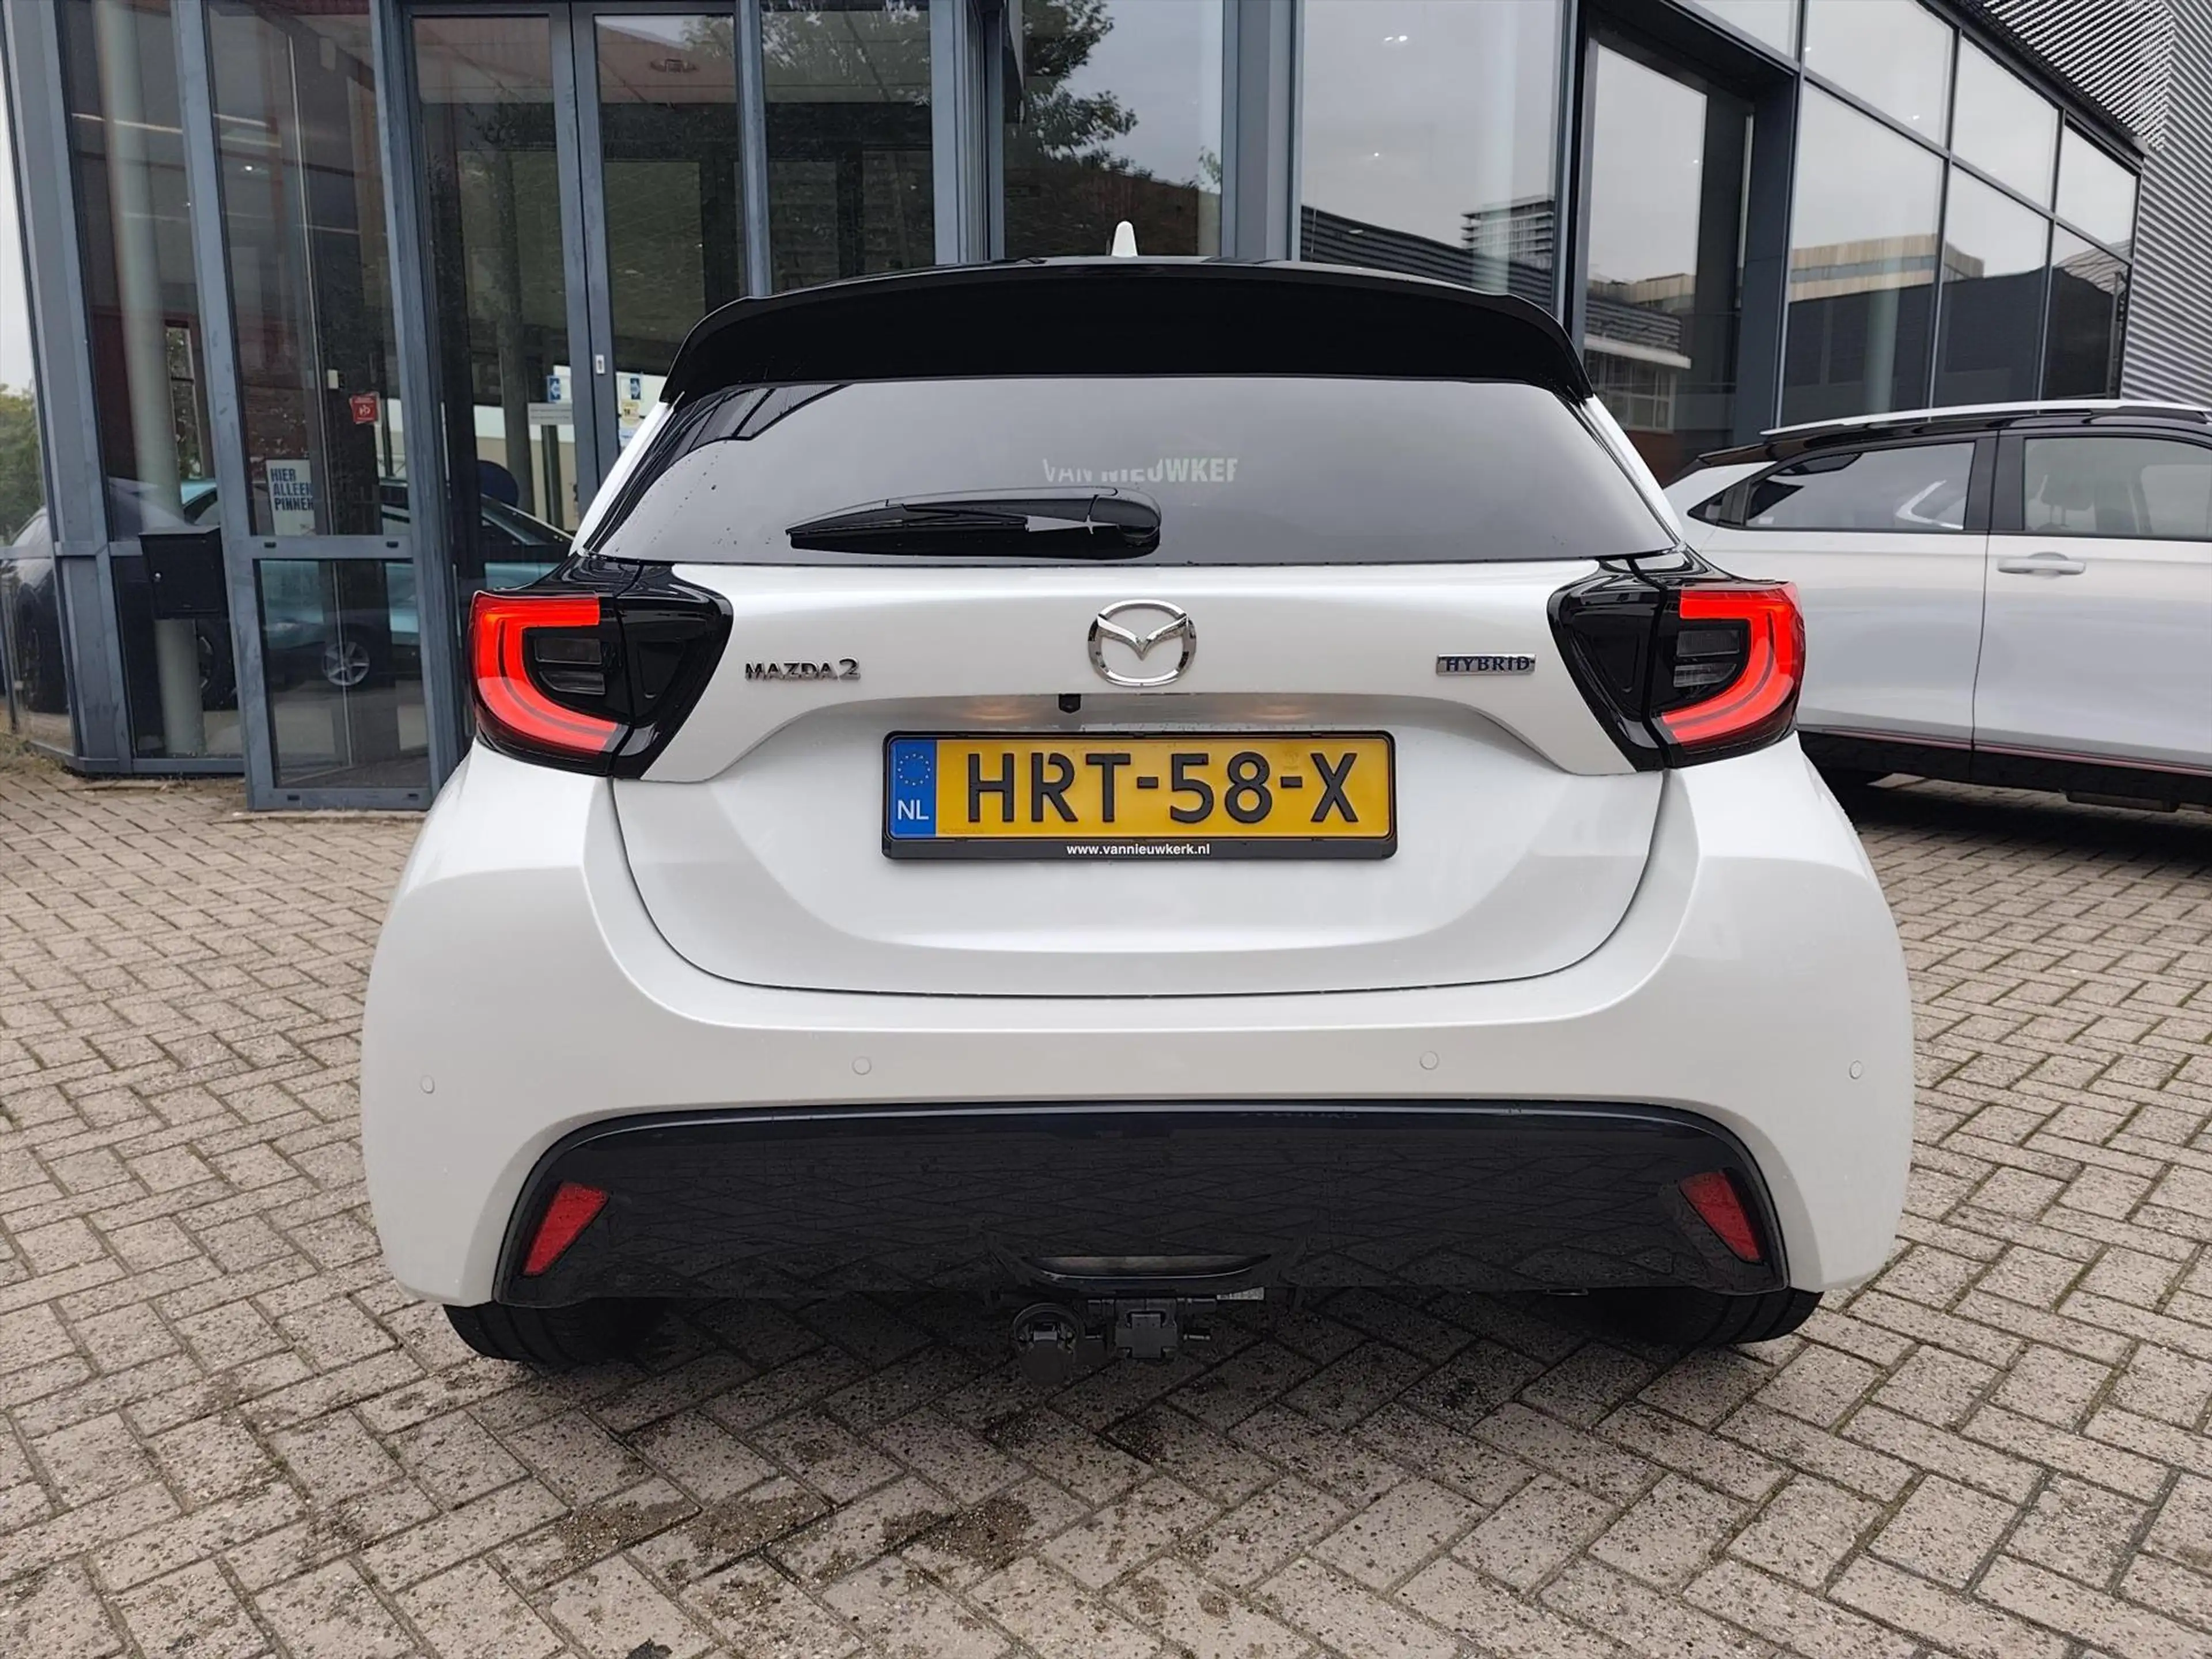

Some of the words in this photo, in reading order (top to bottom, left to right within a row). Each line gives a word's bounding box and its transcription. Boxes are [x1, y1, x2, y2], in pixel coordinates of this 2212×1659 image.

[270, 468, 296, 482] HIER
[1446, 656, 1531, 672] HYBRID
[967, 752, 1359, 824] HRT-58-X
[897, 799, 929, 820] NL
[1066, 843, 1210, 855] www.vannieuwkerk.nl
